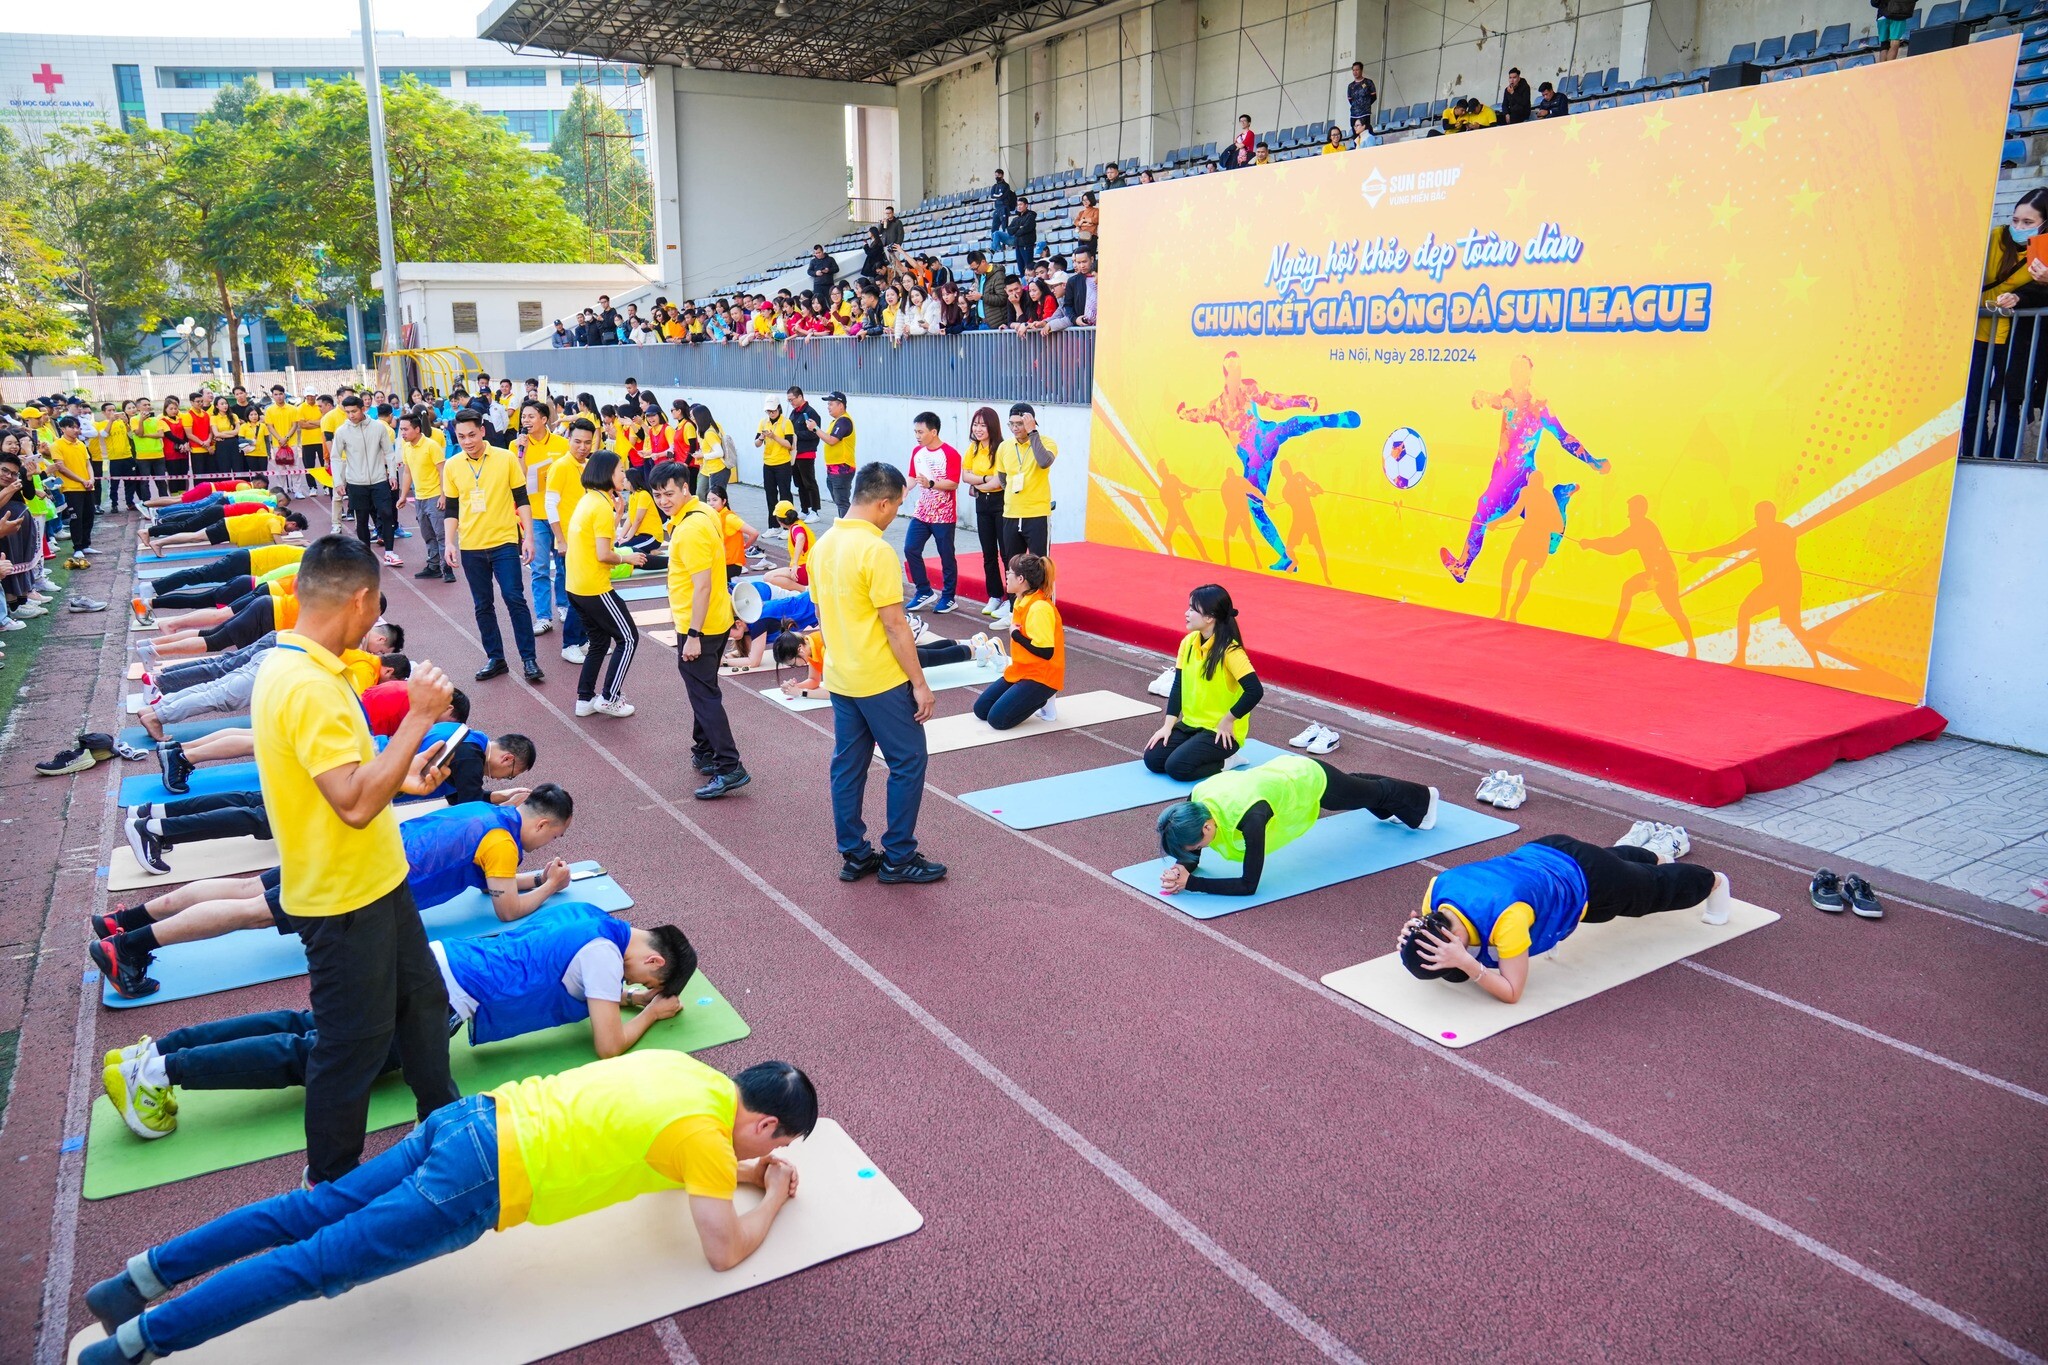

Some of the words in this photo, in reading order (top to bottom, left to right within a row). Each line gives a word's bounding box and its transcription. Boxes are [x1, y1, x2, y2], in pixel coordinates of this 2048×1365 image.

[1389, 173, 1415, 193] SUN
[1417, 167, 1460, 189] GROUP
[1389, 193, 1409, 205] VÙNG
[1411, 191, 1429, 204] MIỀN
[1431, 189, 1447, 200] BẮC
[1264, 242, 1329, 296] Ngày
[1325, 239, 1359, 283] hội
[1360, 236, 1410, 273] khỏe
[1413, 232, 1456, 282] đẹp
[1457, 228, 1520, 269] toàn
[1524, 222, 1583, 263] dân
[1193, 302, 1263, 335] CHUNG
[1266, 291, 1309, 334] KẾT
[1312, 290, 1366, 334] GIẢI
[1369, 288, 1446, 333] BÓNG
[1450, 284, 1494, 333] ĐÁ
[1496, 289, 1564, 332] SUN
[1567, 284, 1711, 332] LEAGUE
[1330, 348, 1344, 360] Hà
[1348, 347, 1371, 364] Nội,
[1374, 348, 1406, 364] Ngày
[1409, 348, 1477, 362] 28.12.2024
